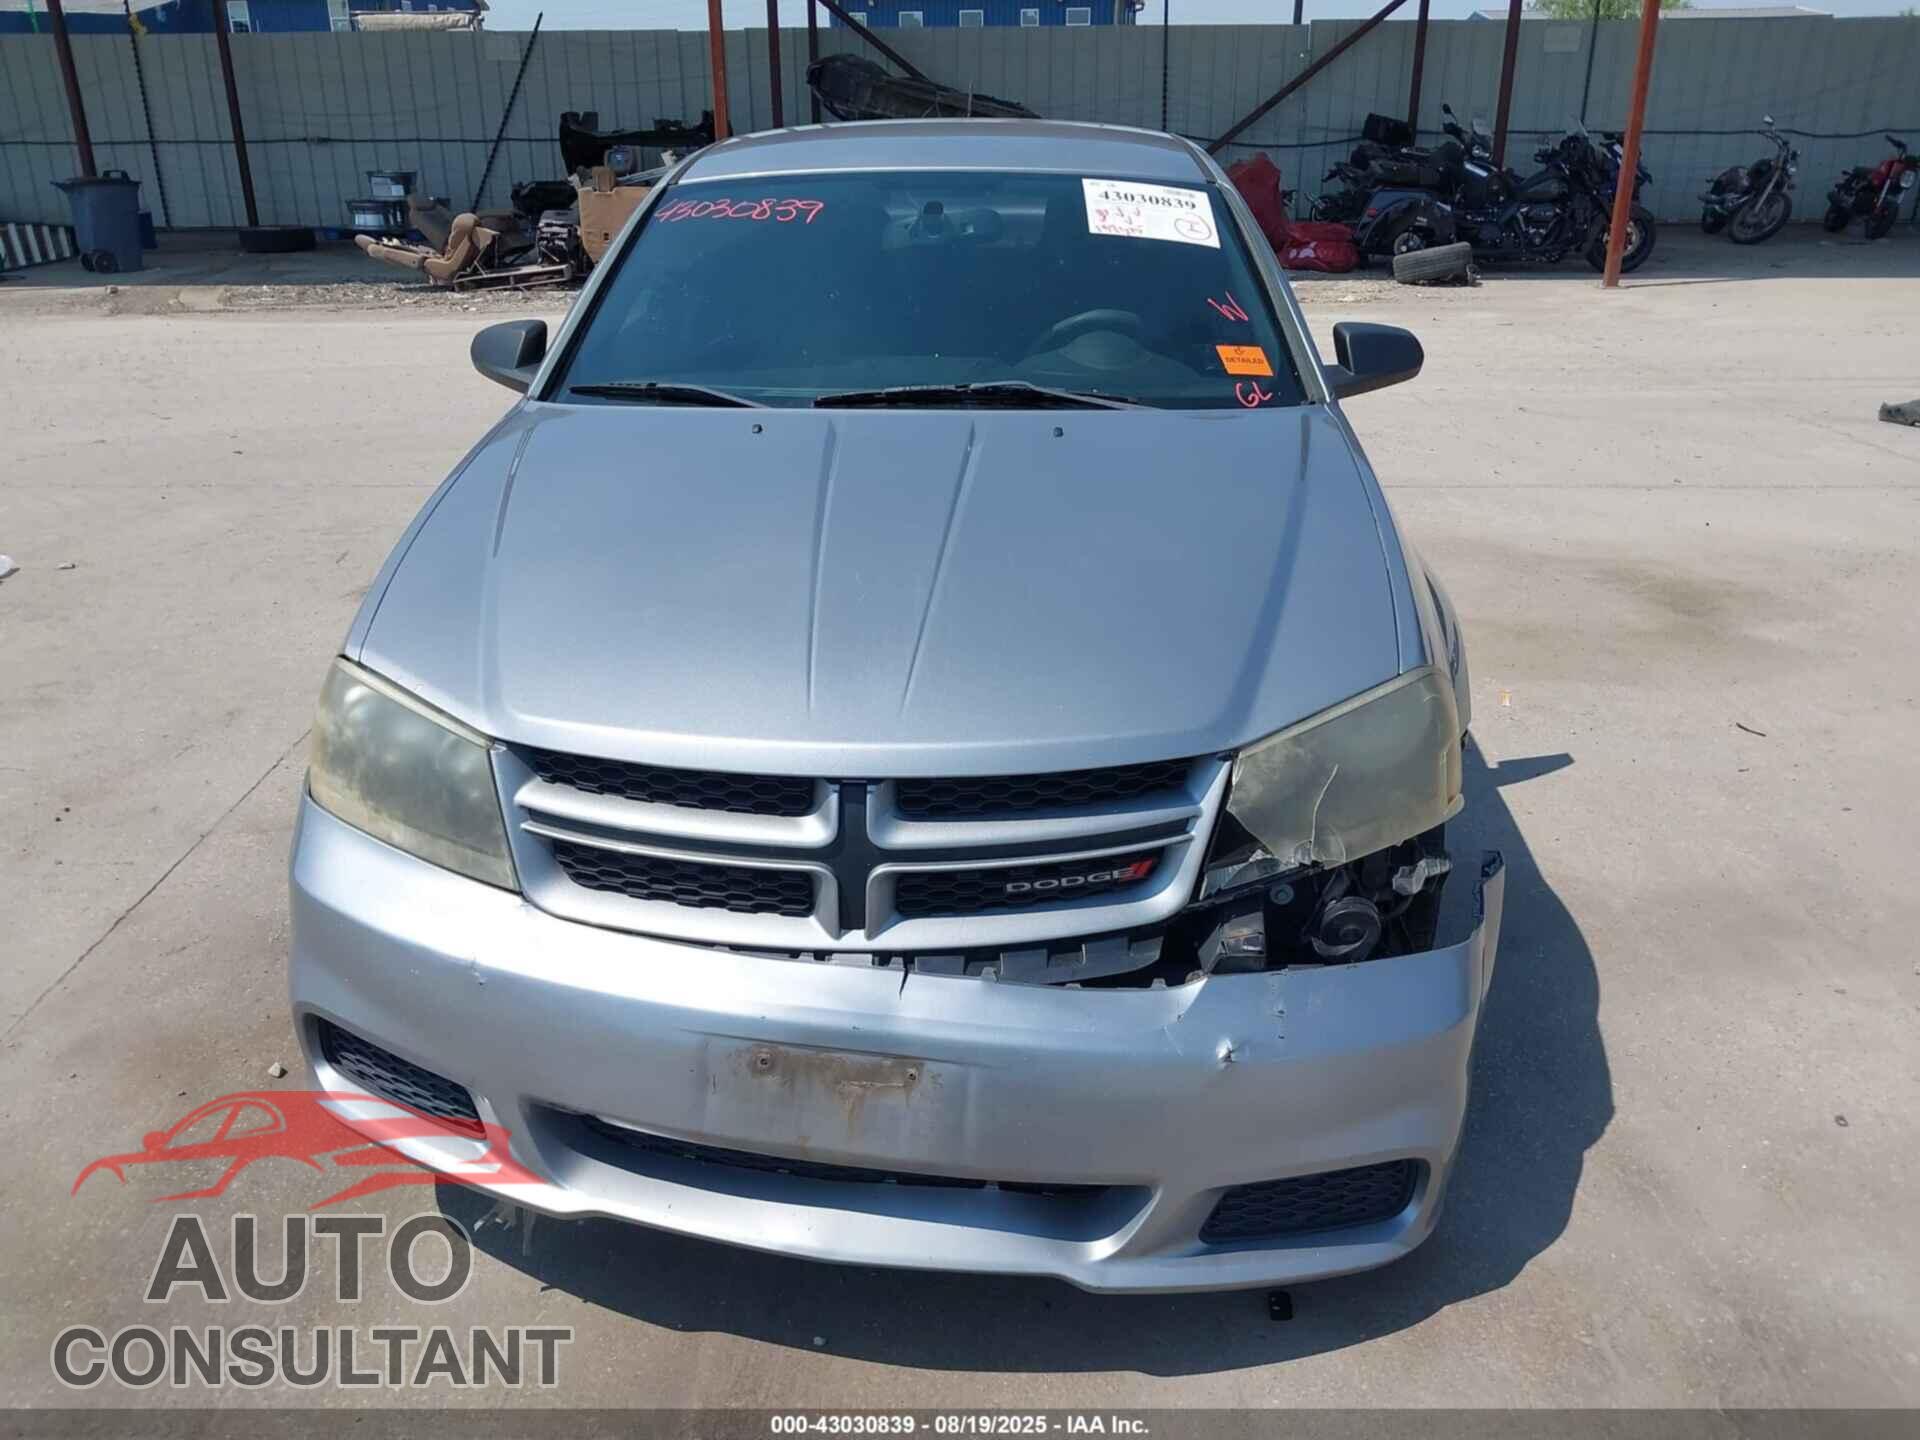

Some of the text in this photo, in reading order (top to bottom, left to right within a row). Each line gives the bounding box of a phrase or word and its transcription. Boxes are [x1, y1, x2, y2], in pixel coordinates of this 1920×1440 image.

[655, 198, 824, 224] 43030839
[1098, 190, 1196, 210] 43030839
[1006, 866, 1137, 892] DODGE
